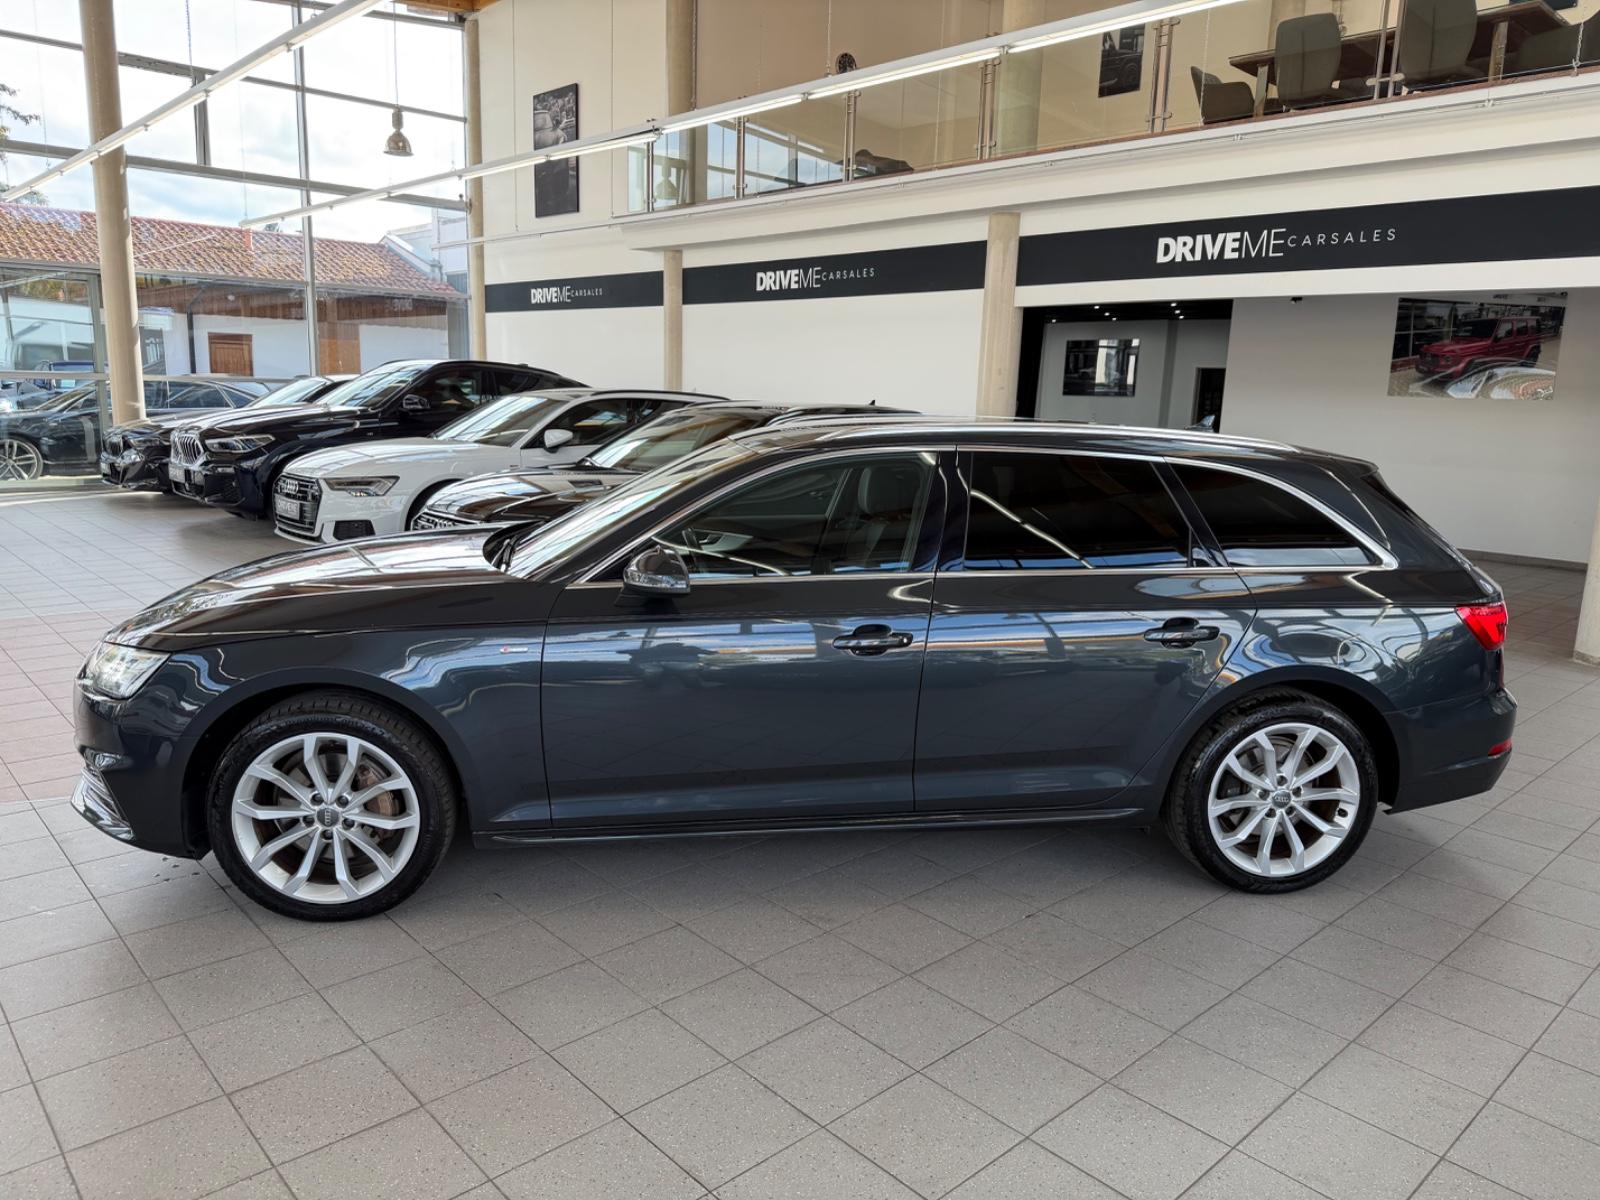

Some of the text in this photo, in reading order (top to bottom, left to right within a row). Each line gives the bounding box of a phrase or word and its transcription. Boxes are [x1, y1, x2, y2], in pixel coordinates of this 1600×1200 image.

[1156, 228, 1397, 263] DRIVEME CARSALES
[756, 267, 875, 291] DRIVEME CARSALES
